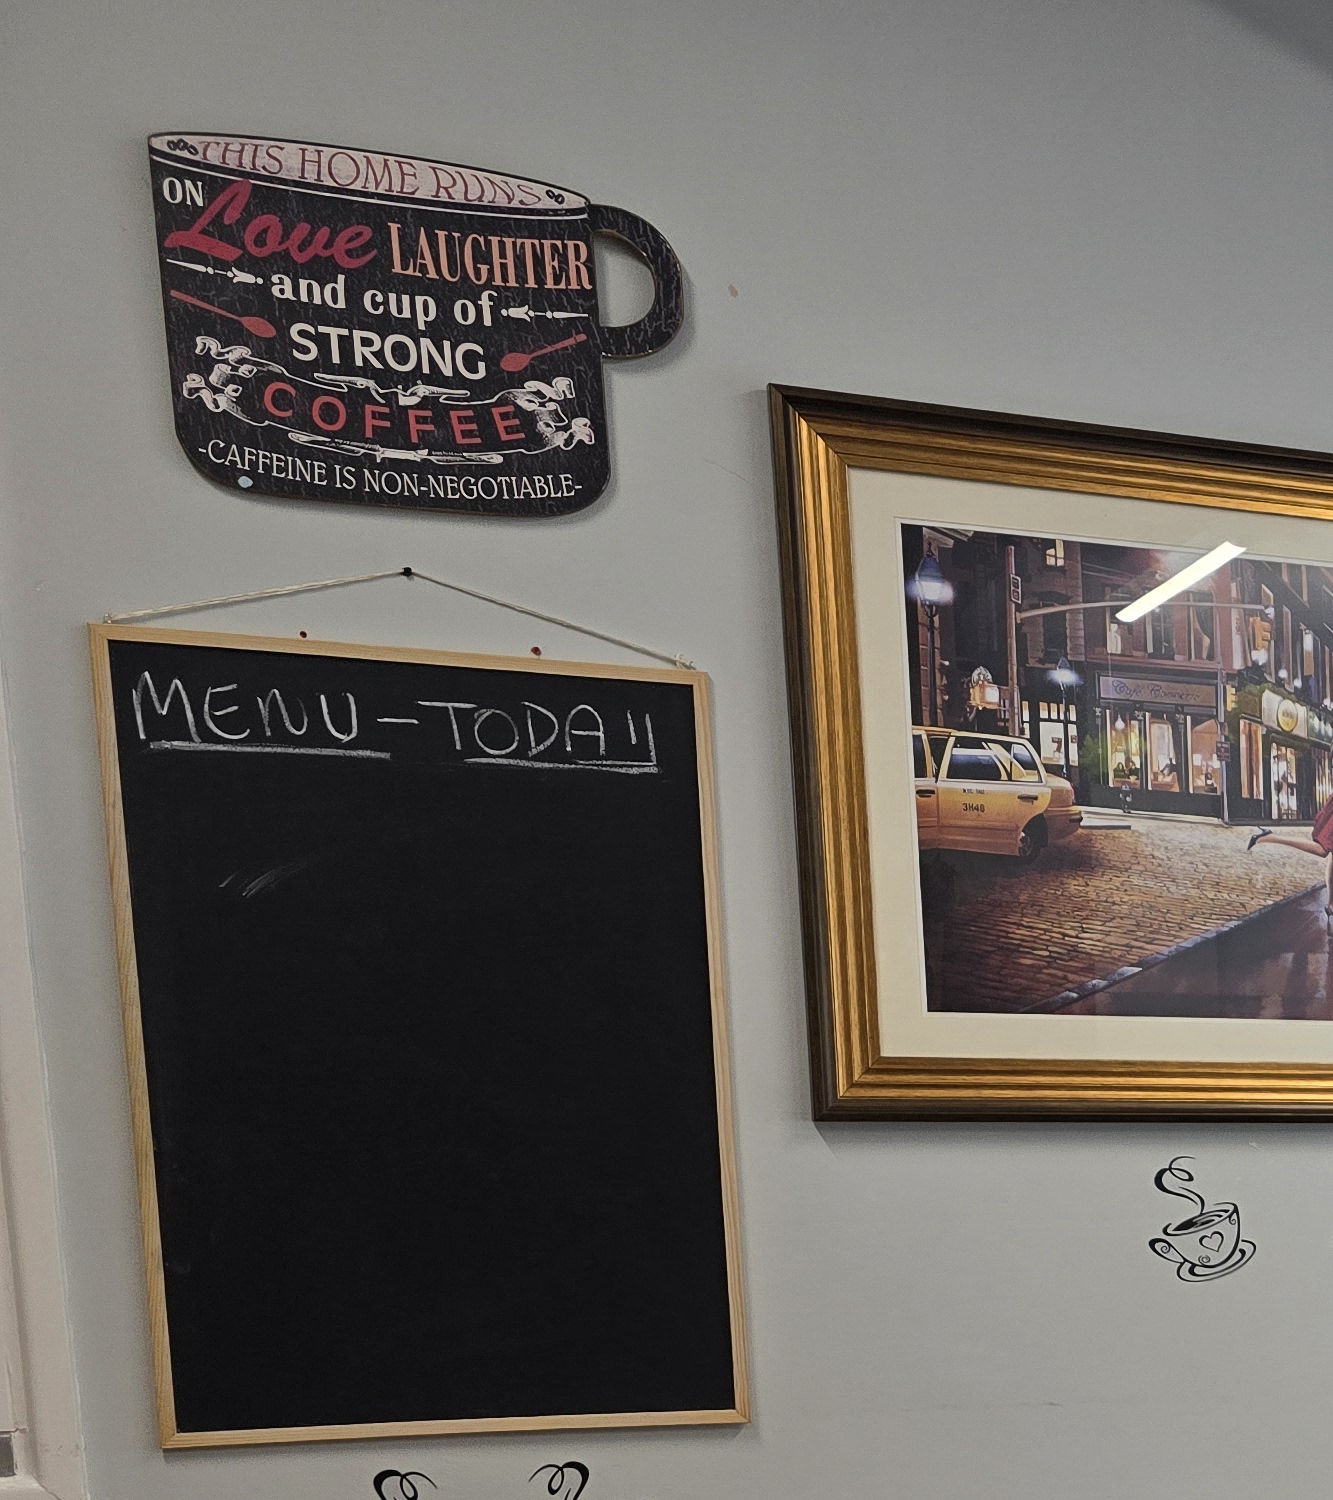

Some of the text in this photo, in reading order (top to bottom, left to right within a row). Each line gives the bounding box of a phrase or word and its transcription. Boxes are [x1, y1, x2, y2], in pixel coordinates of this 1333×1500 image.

[162, 177, 204, 206] ON
[198, 141, 542, 206] THIS HOME RUNS
[164, 179, 378, 269] Love
[388, 222, 593, 290] LAUGHTER
[271, 274, 498, 330] and cup of
[290, 322, 487, 380] STRONG
[264, 382, 526, 444] COFFEE
[334, 464, 356, 490] IS
[132, 670, 358, 742] MENU
